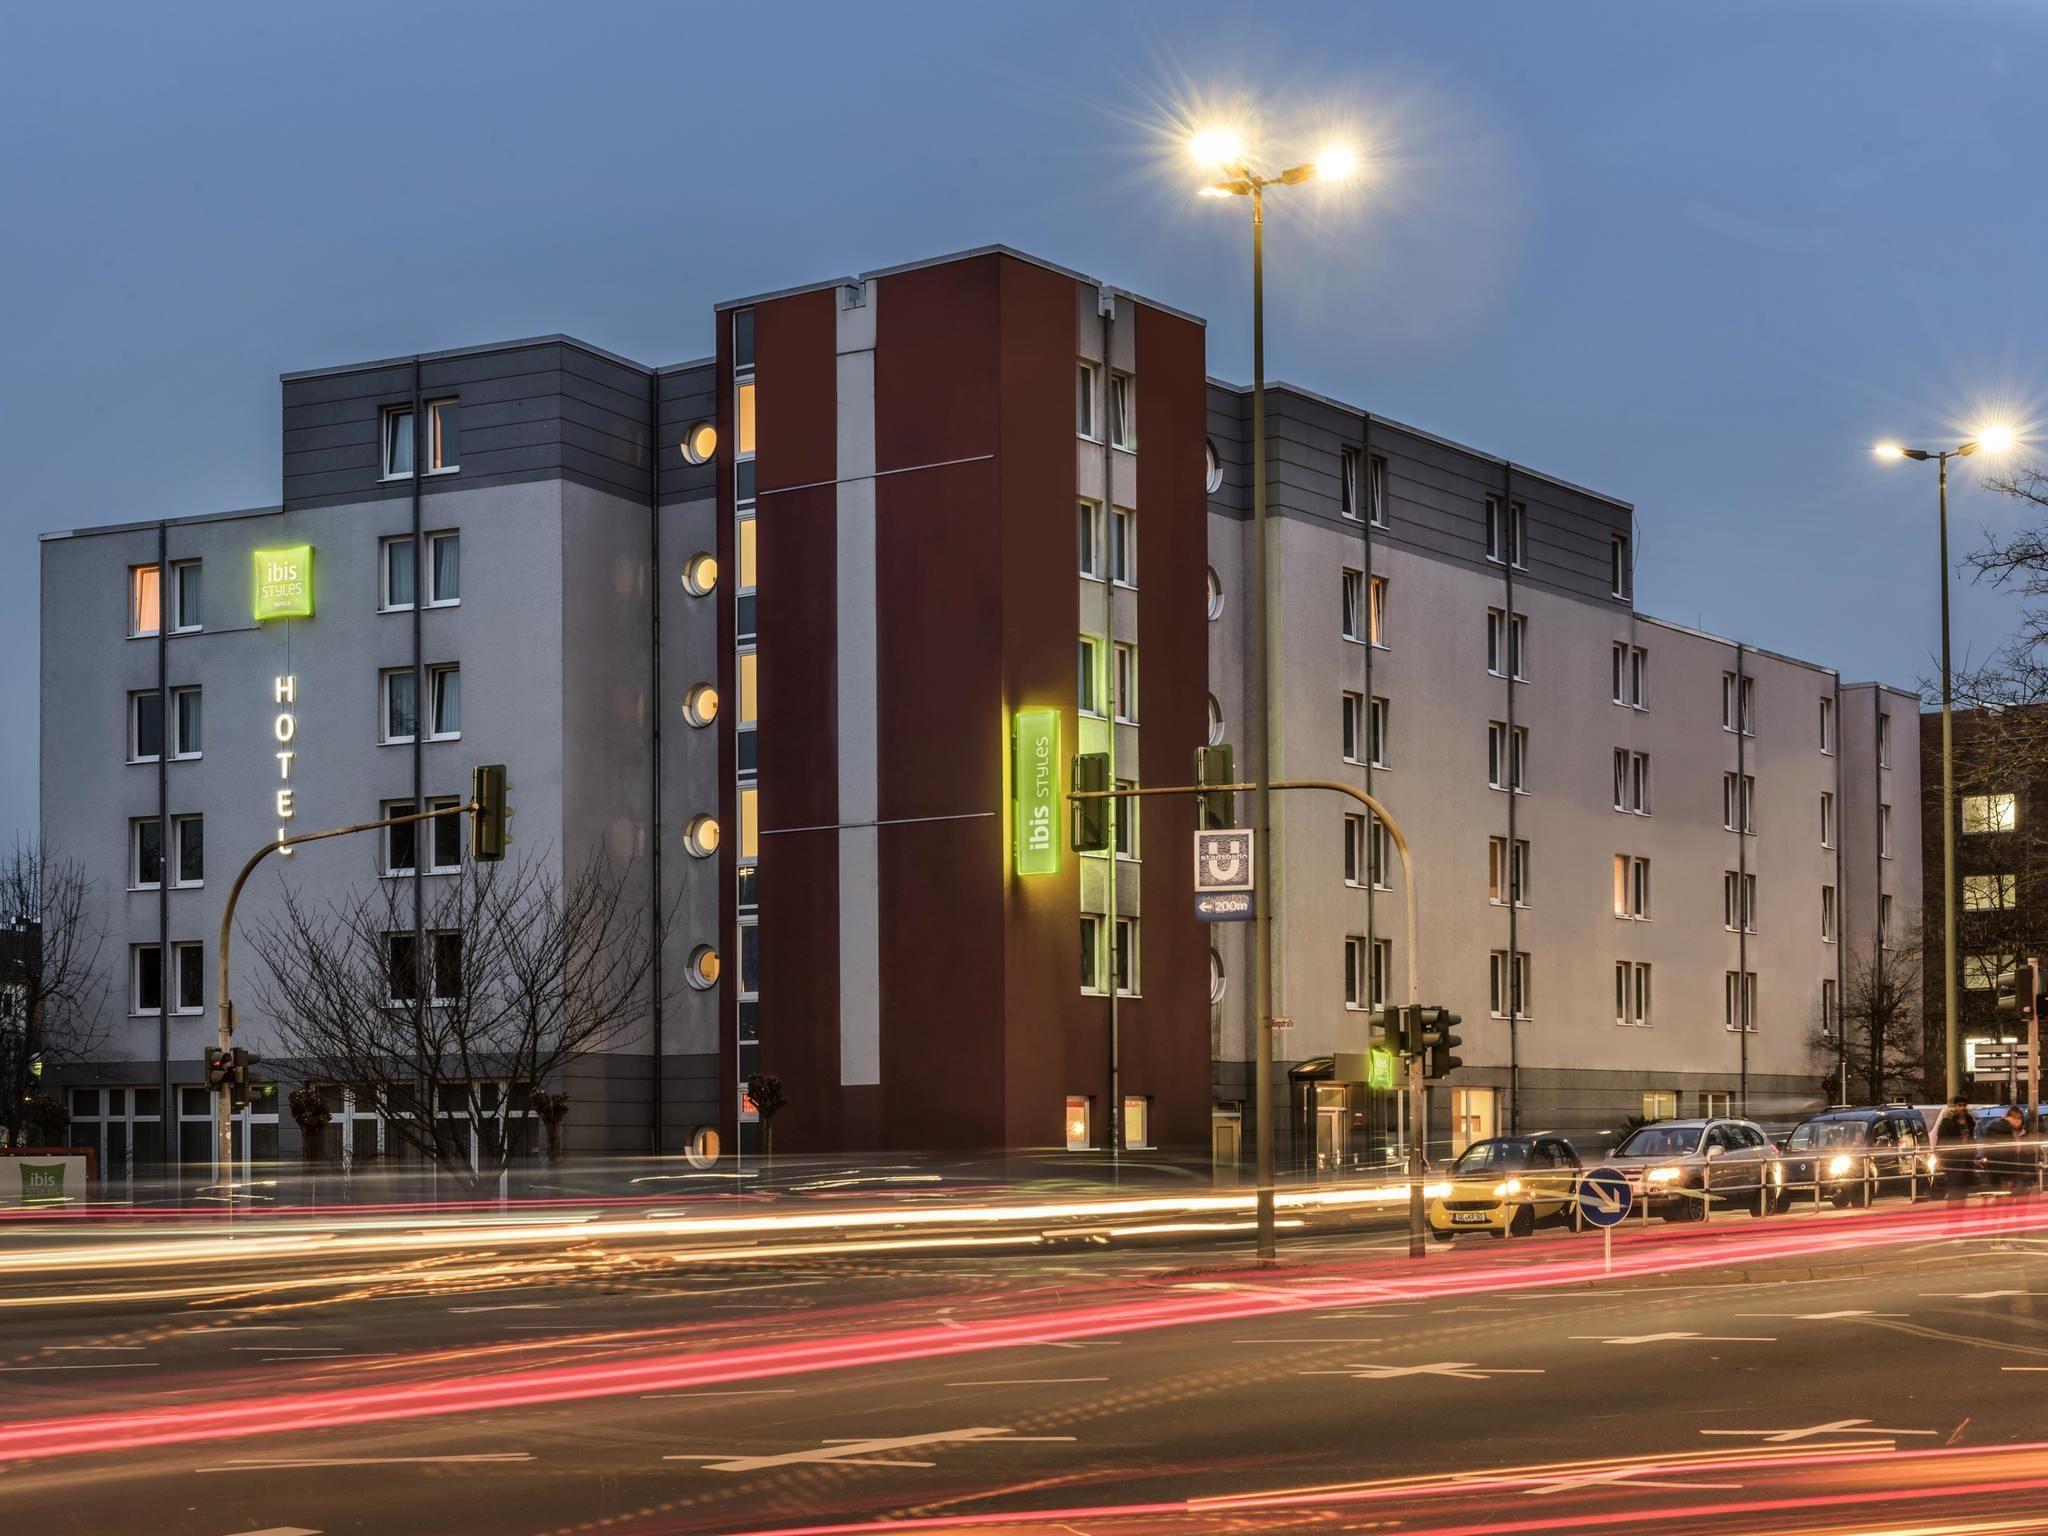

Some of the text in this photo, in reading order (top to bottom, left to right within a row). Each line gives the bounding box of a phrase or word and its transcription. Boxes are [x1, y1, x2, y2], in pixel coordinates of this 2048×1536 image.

[268, 561, 297, 583] ibis
[275, 676, 296, 855] HOTEL
[1029, 805, 1049, 850] ibis
[30, 1172, 55, 1187] ibis
